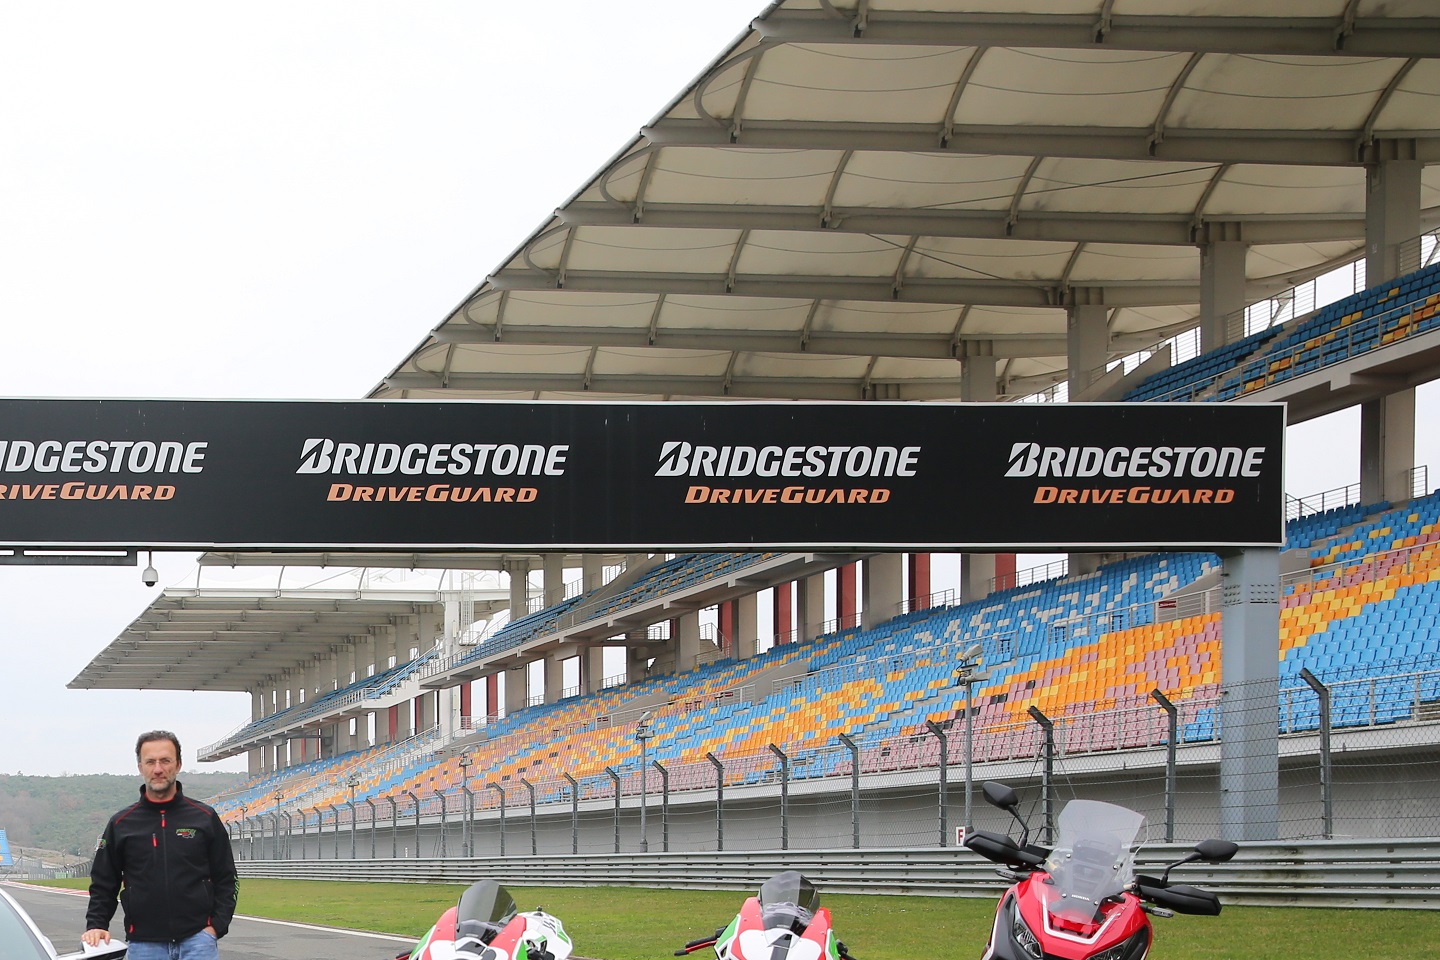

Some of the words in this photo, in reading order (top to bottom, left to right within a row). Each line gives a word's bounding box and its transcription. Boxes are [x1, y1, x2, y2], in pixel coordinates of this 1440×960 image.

[296, 438, 569, 474] BRIDGESTONE
[655, 441, 921, 476] BRIDGESTONE
[1005, 442, 1266, 477] BRIDGESTONE
